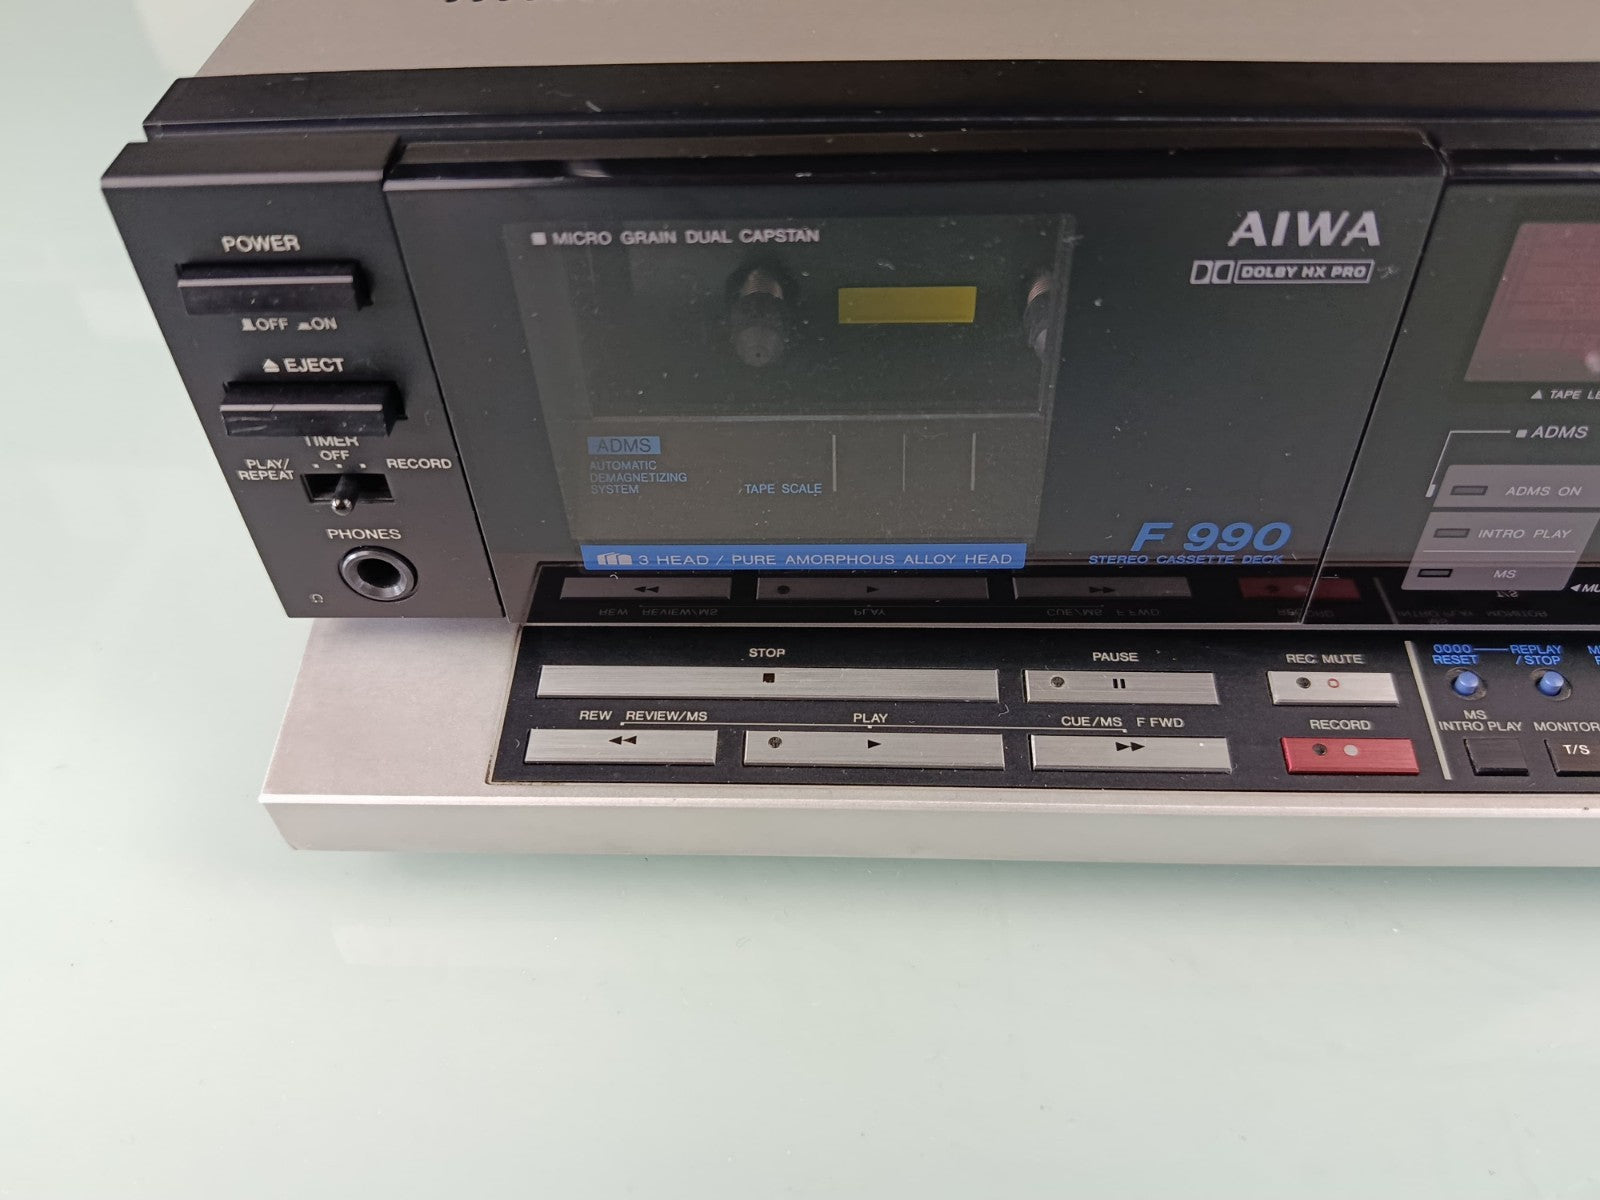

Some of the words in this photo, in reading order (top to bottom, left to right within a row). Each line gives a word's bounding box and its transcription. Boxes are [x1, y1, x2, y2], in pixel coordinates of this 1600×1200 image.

[1227, 210, 1380, 247] AIWA
[552, 231, 612, 246] MICRO
[620, 230, 677, 245] GRAIN
[685, 229, 733, 244] DUAL
[739, 228, 820, 243] CAPSTAN
[221, 234, 301, 252] POWER
[1241, 265, 1298, 278] DOLBY
[1302, 265, 1327, 278] HX
[1331, 265, 1367, 278] PRO
[256, 317, 289, 331] OFF
[311, 317, 338, 330] ON
[283, 357, 345, 373] EJECT
[1550, 390, 1582, 400] TAPE
[1531, 425, 1589, 440] ADMS
[597, 438, 652, 453] ADMS
[320, 450, 350, 461] OFF
[247, 458, 290, 470] PLAY/
[386, 458, 453, 470] RECORD
[590, 461, 657, 470] AUTOMATIC
[238, 470, 294, 481] REPEAT
[590, 472, 688, 483] DEMAGNETIZING
[591, 484, 640, 494] SYSTEM
[745, 483, 776, 494] TAPE
[782, 483, 823, 494] SCALE
[1505, 486, 1551, 497] ADMS
[1558, 486, 1583, 497] ON
[327, 528, 402, 540] PHONES
[1130, 522, 1174, 551] F
[1183, 522, 1294, 551] 990
[1478, 529, 1525, 539] INTRO
[1533, 529, 1573, 539] PLAY
[638, 554, 649, 566] 3
[657, 554, 709, 566] HEAD
[732, 554, 777, 566] PURE
[785, 554, 896, 566] AMORPHOUS
[904, 554, 957, 565] ALLOY
[965, 553, 1013, 565] HEAD
[1088, 555, 1149, 566] STEREO
[1157, 555, 1235, 565] CASSETTE
[1242, 555, 1284, 565] DECK
[1494, 570, 1518, 579] MS
[749, 648, 785, 657] STOP
[1433, 644, 1472, 654] 0000
[1510, 645, 1562, 654] REPLAY
[1092, 652, 1139, 662] PAUSE
[1322, 654, 1364, 664] MUTE
[1432, 655, 1478, 665] RESET
[579, 711, 612, 721] REW
[625, 711, 708, 722] REVIEW/MS
[853, 713, 888, 724] PLAY
[1464, 710, 1487, 720] MS
[1061, 716, 1123, 727] CUE/MS
[1150, 717, 1185, 728] FWD
[1310, 719, 1371, 731] RECORD
[1439, 721, 1484, 731] INTRO
[1488, 721, 1522, 731] PLAY
[1534, 721, 1600, 732] MONITOR
[1562, 744, 1591, 755] T/S
